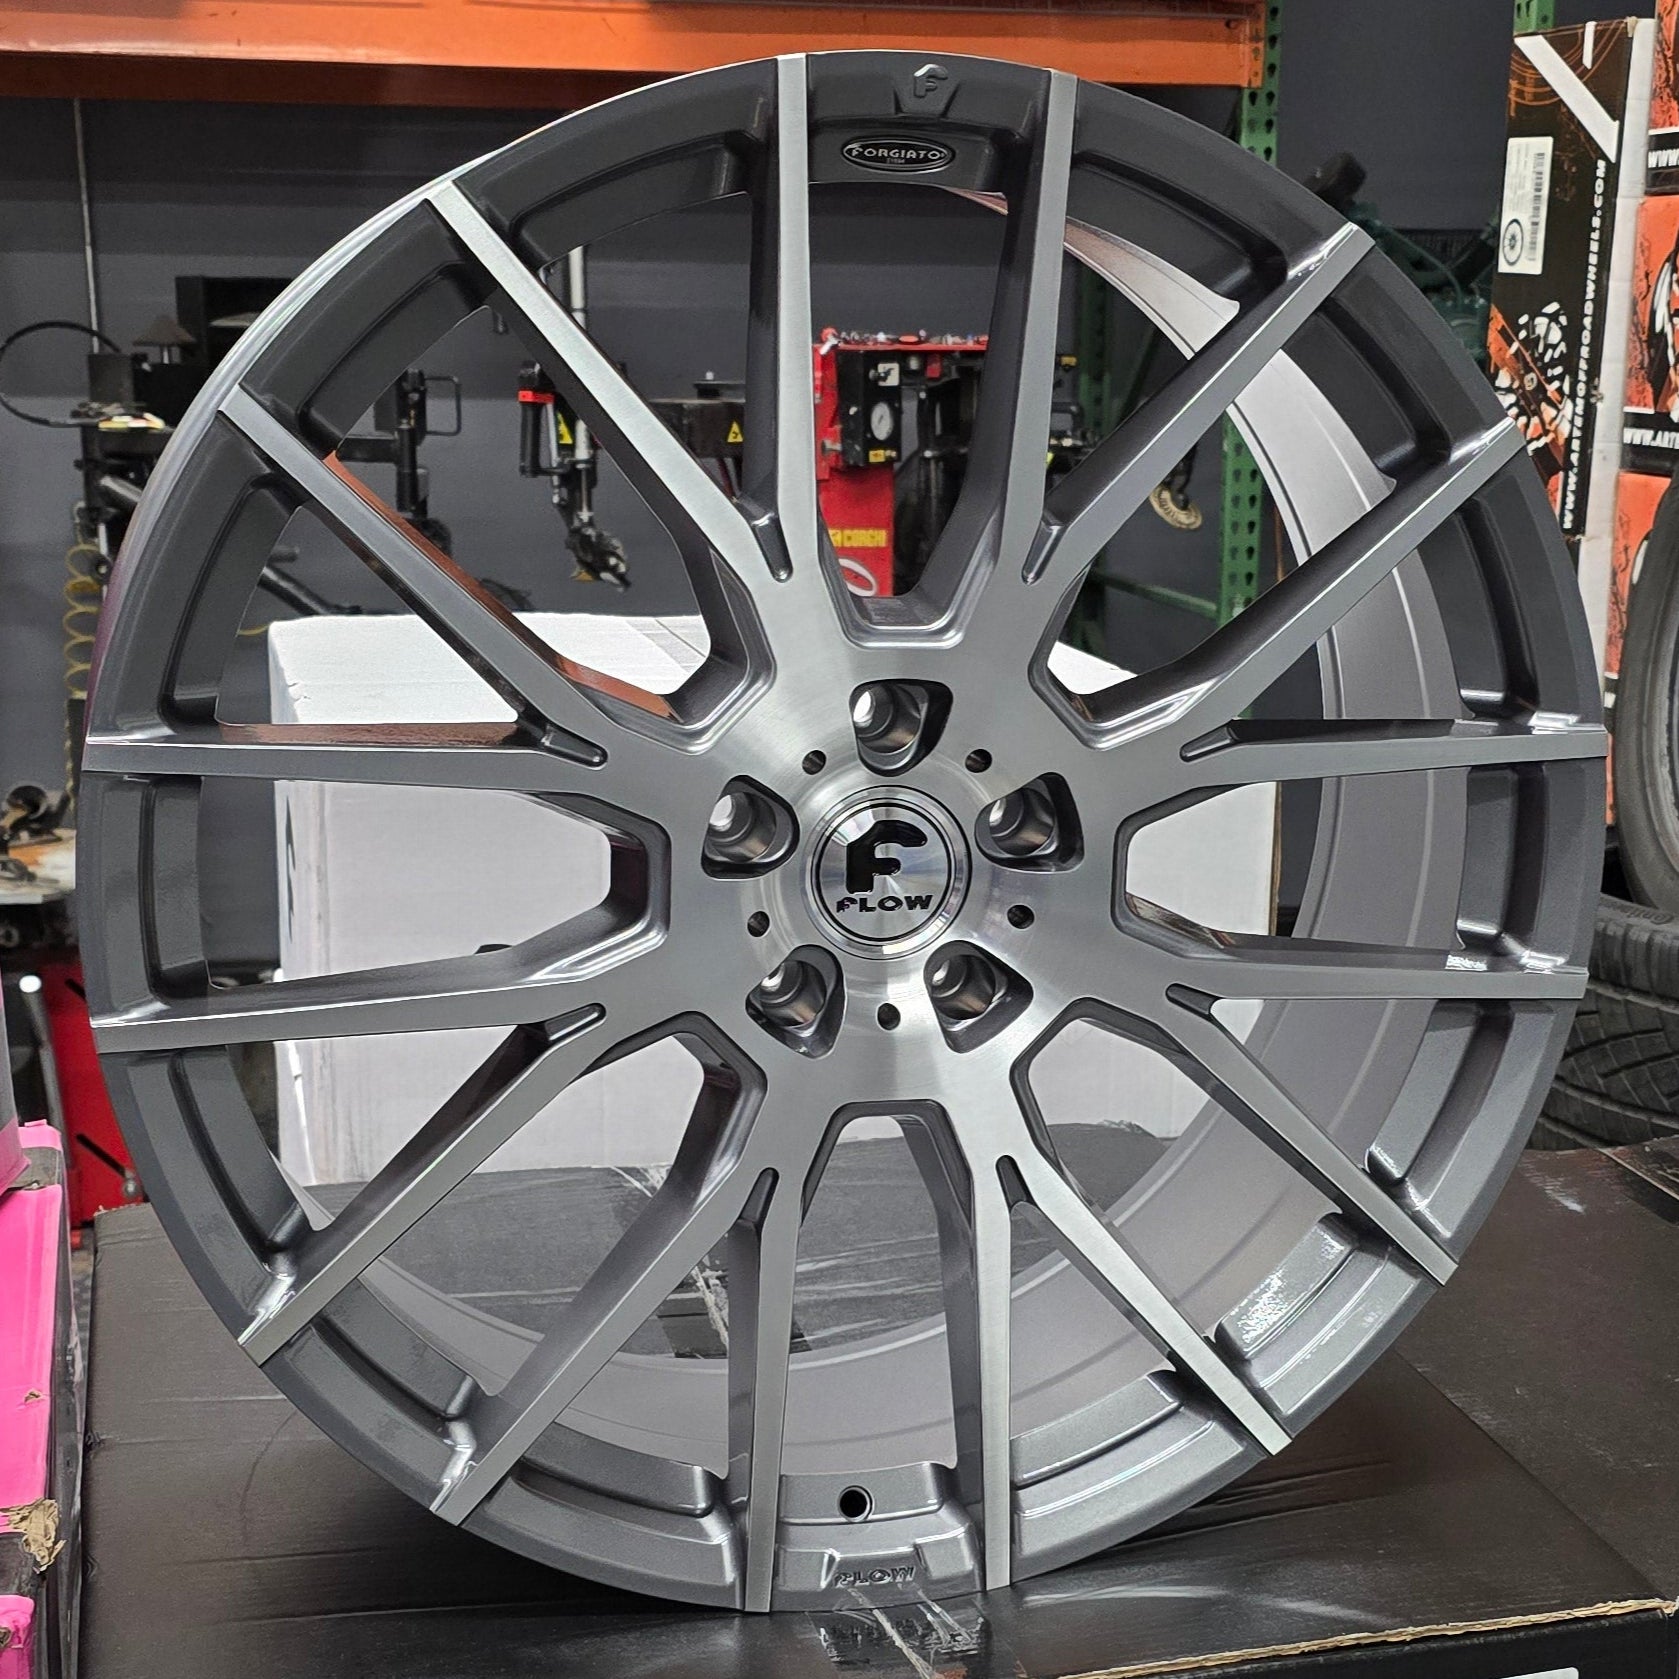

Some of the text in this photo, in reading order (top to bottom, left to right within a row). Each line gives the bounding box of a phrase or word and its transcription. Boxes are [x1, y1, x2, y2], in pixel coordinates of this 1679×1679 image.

[852, 147, 941, 160] FORGIATO
[846, 820, 928, 894] F
[836, 895, 933, 913] FLOW
[834, 1567, 916, 1588] FLOW
